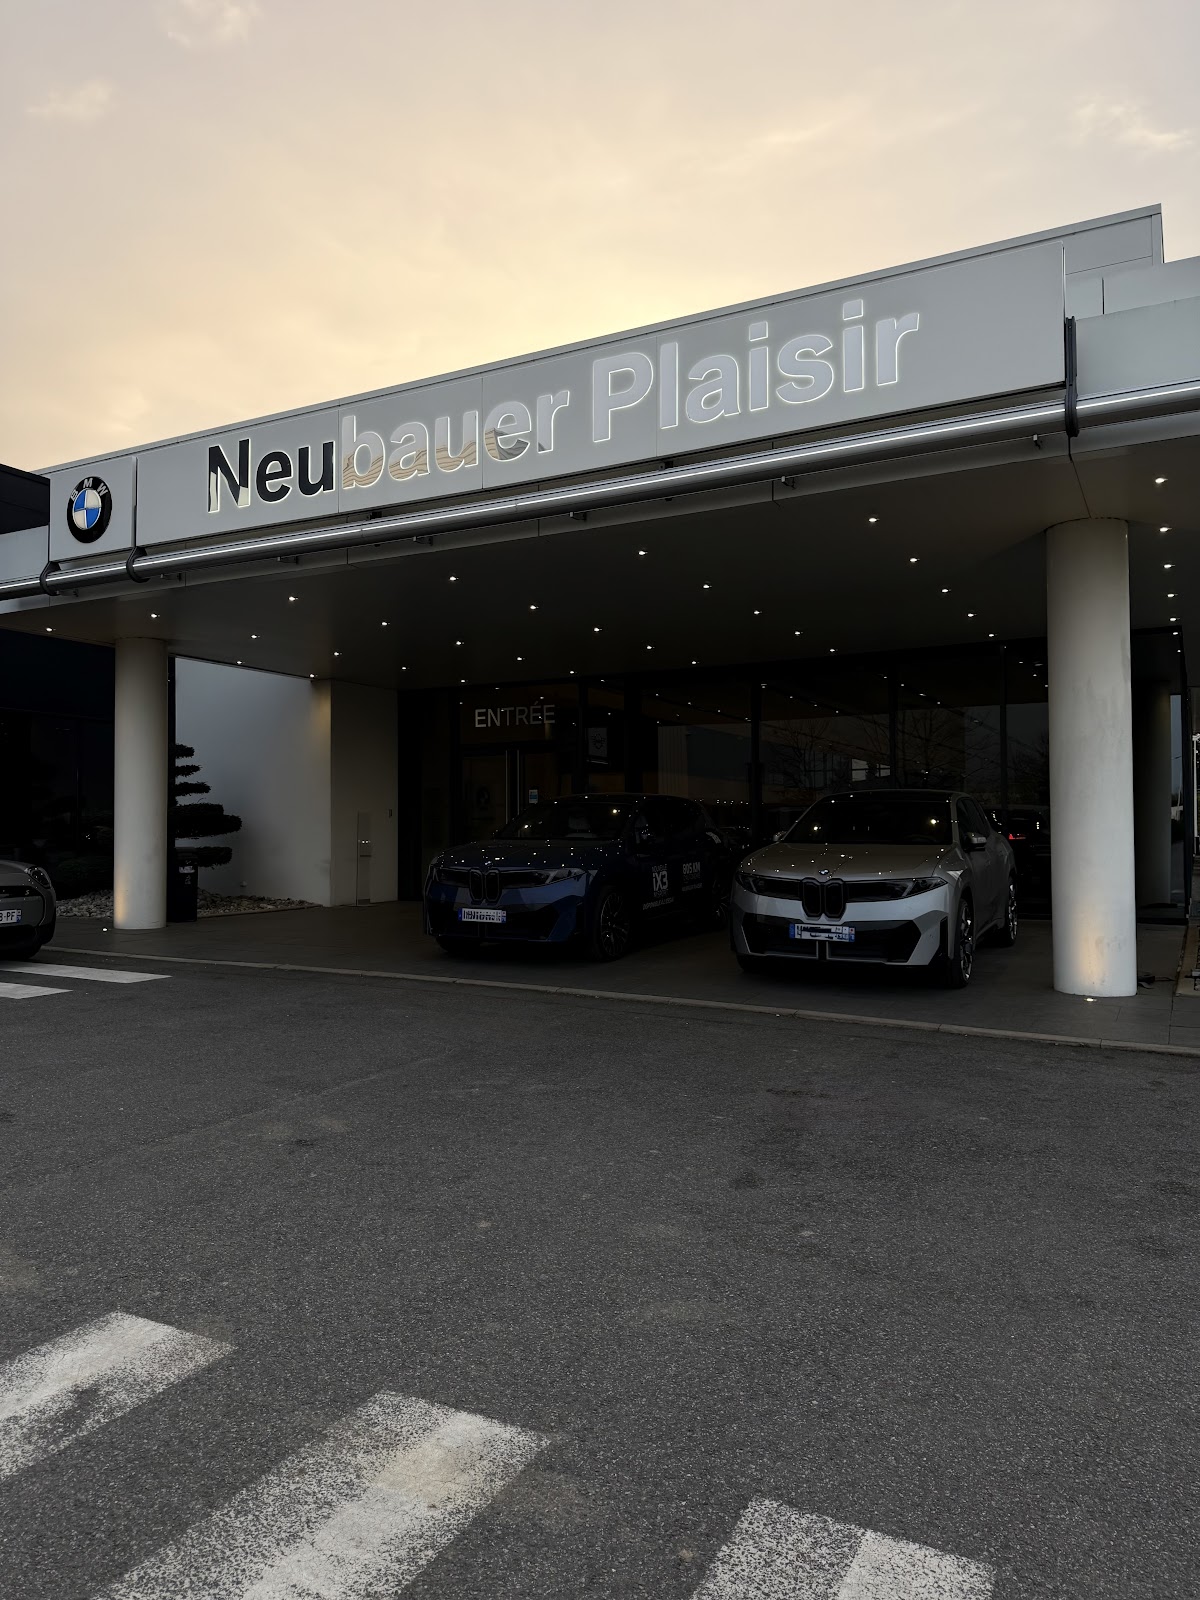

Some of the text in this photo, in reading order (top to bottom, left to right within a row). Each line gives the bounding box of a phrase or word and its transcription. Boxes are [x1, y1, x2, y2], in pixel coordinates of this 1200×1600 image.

[208, 298, 920, 514] Neubauer Plaisir
[70, 478, 109, 502] BMW
[474, 700, 556, 728] ENTRÉE
[652, 871, 668, 891] iX3
